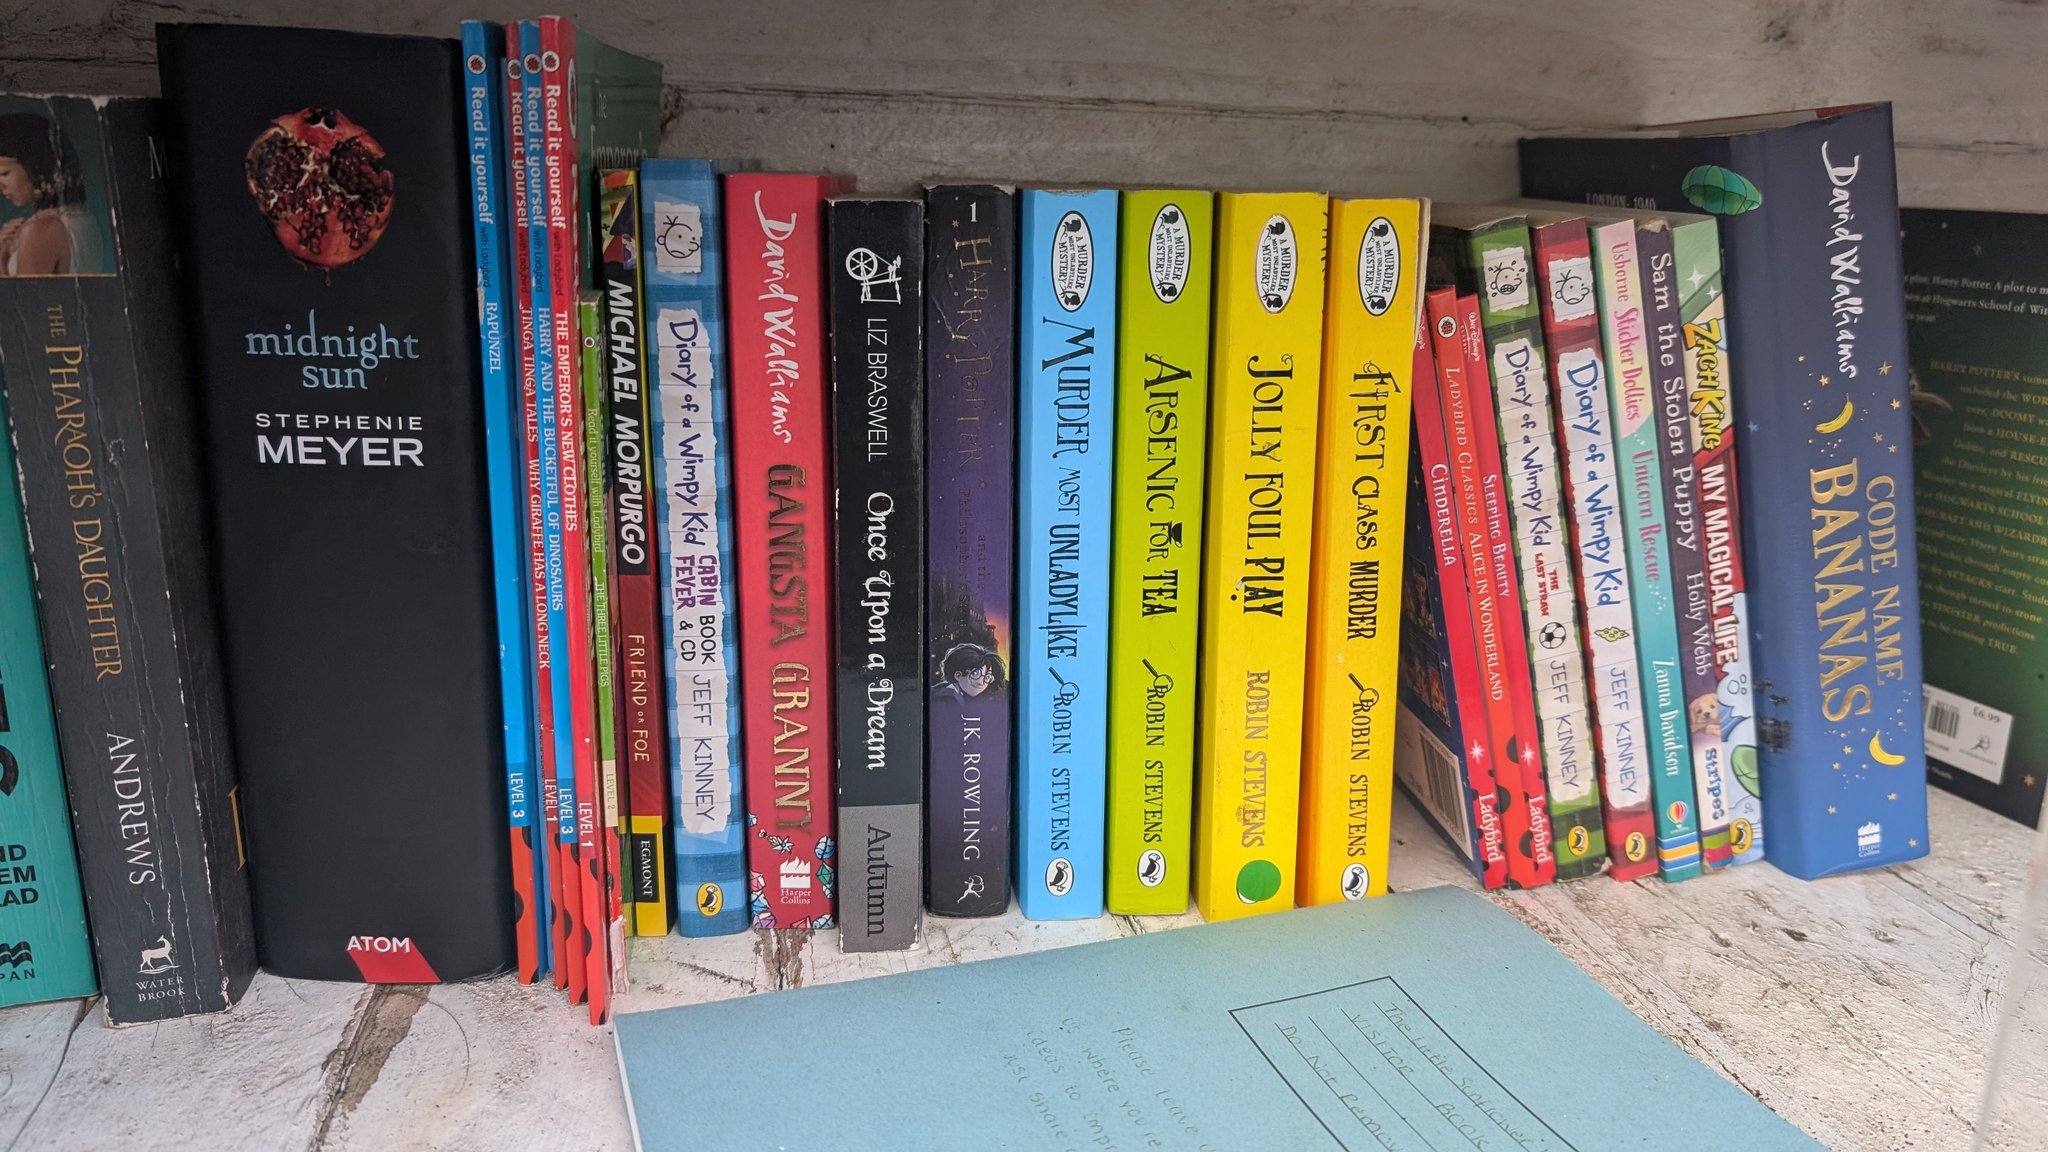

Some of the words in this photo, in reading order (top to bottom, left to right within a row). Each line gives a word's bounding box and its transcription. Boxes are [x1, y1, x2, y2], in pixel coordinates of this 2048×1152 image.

[471, 87, 487, 132] Read
[546, 85, 562, 132] Read
[471, 154, 493, 224] yourself
[527, 156, 546, 228] yourself
[545, 155, 566, 230] yourself
[1821, 140, 1862, 247] David
[480, 227, 489, 246] with
[480, 248, 492, 287] Ladybird
[754, 190, 799, 302] David
[1075, 244, 1088, 289] MURDER
[1172, 235, 1185, 280] MURDER
[1278, 248, 1291, 291] MURDER
[1382, 249, 1395, 293] MURDER
[1611, 241, 1631, 302] Usborne
[1650, 252, 1672, 312] Sam
[2003, 282, 2024, 293] plot
[2026, 285, 2037, 293] to
[47, 304, 66, 337] THE
[486, 302, 501, 374] RAPUNZEL
[539, 307, 552, 357] HARRY
[556, 311, 568, 342] THE
[867, 318, 887, 346] LIZ
[1614, 308, 1640, 365] Sticker
[1829, 244, 1863, 378] Walliams
[1978, 300, 2012, 312] School
[2014, 303, 2025, 313] of
[246, 309, 419, 370] midnight
[608, 279, 638, 403] MICHAEL
[669, 318, 697, 388] Diary
[1656, 323, 1675, 367] the
[1682, 318, 1722, 389] ZACH
[302, 366, 367, 389] sun
[557, 345, 572, 427] EMPEROR'S
[681, 394, 699, 413] of
[763, 307, 800, 443] Walliams
[1042, 316, 1095, 459] MURDER
[1505, 345, 1533, 407] Diary
[1566, 359, 1601, 436] Diary
[1620, 366, 1645, 421] Dollies
[44, 345, 102, 509] PHARAOH'S
[256, 413, 422, 431] STEPHENIE
[588, 409, 598, 432] Read
[867, 353, 888, 462] BRASWELL
[1144, 353, 1192, 512] ARSENIC
[1247, 353, 1293, 462] JOLLY
[1348, 360, 1401, 469] FIRST
[1663, 376, 1687, 456] Stolen
[1690, 388, 1726, 450] KING
[257, 435, 424, 466] MEYER
[543, 428, 557, 507] BUCKETFUL
[588, 446, 600, 486] yourself
[674, 433, 703, 506] Wimpy
[1521, 446, 1543, 512] Wimpy
[563, 468, 577, 532] CLOTHES
[591, 488, 600, 506] with
[615, 414, 645, 564] MORPURGO
[1058, 466, 1080, 516] MOST
[1244, 473, 1284, 550] FOUL
[1352, 475, 1380, 551] CLASS
[1632, 450, 1655, 520] Unicorn
[1672, 463, 1696, 551] Puppy
[1701, 463, 1727, 503] MY
[530, 494, 543, 550] GIRAFFE
[592, 510, 604, 552] Ladybird
[682, 513, 708, 546] Kid
[867, 492, 895, 561] Once
[1147, 521, 1169, 562] FOR
[1431, 464, 1456, 567] CINDERELLA
[1446, 367, 1467, 446] LADYBIRD
[1458, 452, 1478, 525] CLASSICS
[1469, 532, 1485, 578] ALICE
[1477, 597, 1503, 701] WONDERLAND
[1483, 474, 1500, 540] SLEEPING
[1492, 543, 1510, 597] BEAUTY
[1529, 515, 1552, 546] Kid
[1582, 484, 1613, 564] Wimpy
[1866, 474, 1898, 574] CODE
[548, 534, 563, 611] DINOSAURS
[673, 555, 696, 610] FEVER
[697, 554, 718, 606] CABIN
[767, 464, 808, 647] GANGSTA
[1638, 523, 1662, 583] Rescue
[1705, 507, 1733, 614] MAGICAL
[72, 518, 122, 682] DAUGHTER
[861, 570, 895, 644] Upon
[1044, 522, 1083, 659] UNLADYLIKE
[1142, 570, 1178, 618] TEA
[1240, 556, 1285, 618] PLAY
[1347, 560, 1380, 641] MURDER
[1593, 568, 1623, 606] Kid
[1684, 572, 1707, 622] Holly
[1809, 457, 1873, 722] BANANAS
[680, 639, 695, 662] CD
[699, 615, 716, 664] BOOK
[1692, 622, 1712, 676] Webb
[1711, 615, 1738, 665] LIFE
[1872, 585, 1904, 685] NAME
[628, 634, 649, 706] FRIEND
[693, 675, 712, 727] JEFF
[1550, 659, 1570, 704] JEFF
[1609, 667, 1629, 712] JEFF
[1652, 656, 1676, 708] Zanna
[867, 678, 893, 770] Dream
[961, 714, 981, 746] J.K.
[1053, 692, 1075, 754] ROBIN
[1146, 685, 1168, 746] ROBIN
[1245, 670, 1271, 740] ROBIN
[1351, 698, 1374, 760] ROBIN
[632, 729, 650, 762] FOE
[772, 662, 813, 835] GRANNY
[1556, 714, 1579, 788] KINNEY
[1615, 721, 1637, 794] KINNEY
[1659, 710, 1684, 776] Davidson
[106, 731, 156, 885] ANDREWS
[510, 772, 524, 805] LEVEL
[694, 738, 715, 822] KINNEY
[963, 752, 981, 861] ROWLING
[1051, 768, 1071, 851] STEVENS
[1143, 760, 1163, 843] STEVENS
[1241, 750, 1268, 848] STEVENS
[579, 802, 593, 836] LEVEL
[1347, 774, 1369, 857] STEVENS
[1478, 792, 1504, 864] Ladybird
[1528, 795, 1552, 864] Ladybird
[641, 840, 653, 896] EGMONT
[867, 823, 893, 937] Autumn
[347, 936, 410, 954] ATOM
[1065, 1083, 1081, 1100] to
[1081, 1047, 1120, 1093] where
[1385, 1002, 1411, 1033] The
[1456, 1076, 1534, 1144] Sunflower
